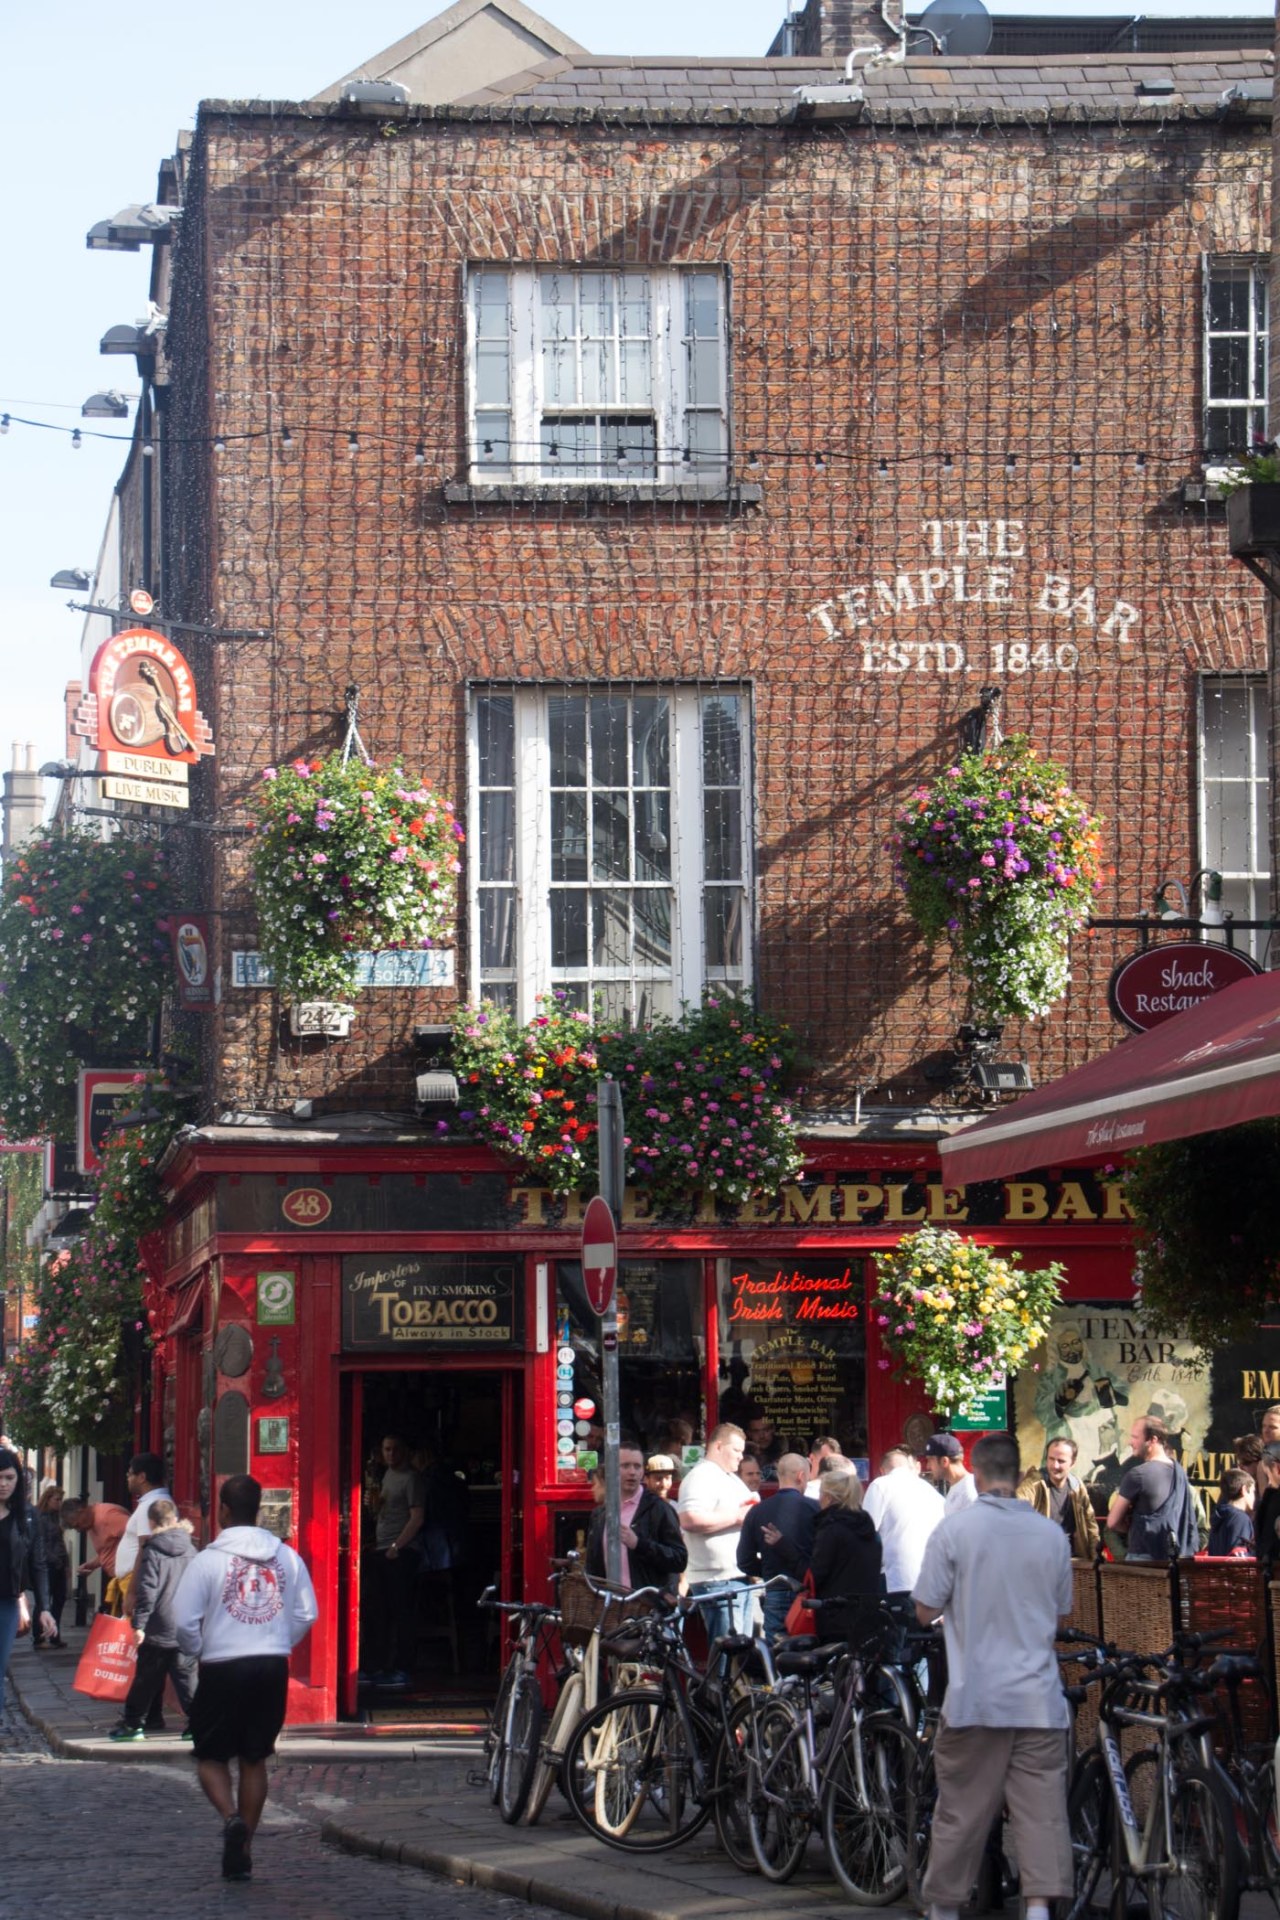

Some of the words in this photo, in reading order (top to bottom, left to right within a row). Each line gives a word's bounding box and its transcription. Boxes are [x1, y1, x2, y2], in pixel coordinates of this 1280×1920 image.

[921, 520, 1024, 557] THE
[805, 565, 1015, 642] TEMPLE
[1036, 573, 1142, 643] BAR
[860, 640, 973, 674] ESTD.
[990, 642, 1080, 674] 1840
[101, 655, 119, 699] THE
[116, 635, 178, 669] TEMPLE
[172, 666, 193, 712] BAR
[123, 756, 173, 776] DUBLIN
[114, 781, 142, 798] LIVE
[1161, 958, 1215, 990] Shack
[291, 1193, 321, 1217] 48
[1004, 1182, 1137, 1220] BAR
[349, 1262, 421, 1293] Importers
[394, 1279, 407, 1289] OF
[412, 1285, 440, 1296] FINE
[441, 1284, 497, 1296] SMOKING
[732, 1268, 853, 1296] Traditional
[368, 1292, 498, 1336] TOBACCO
[729, 1297, 783, 1321] Irish
[795, 1296, 859, 1320] Music
[395, 1327, 444, 1340] Always
[450, 1328, 464, 1338] in
[467, 1327, 509, 1338] Stock
[751, 1336, 806, 1361] TEMPLE
[810, 1339, 838, 1361] BAR
[1119, 1342, 1176, 1364] BAR
[249, 1578, 261, 1593] R
[97, 1641, 127, 1655] TEMPLE
[93, 1667, 129, 1683] DUBLIN
